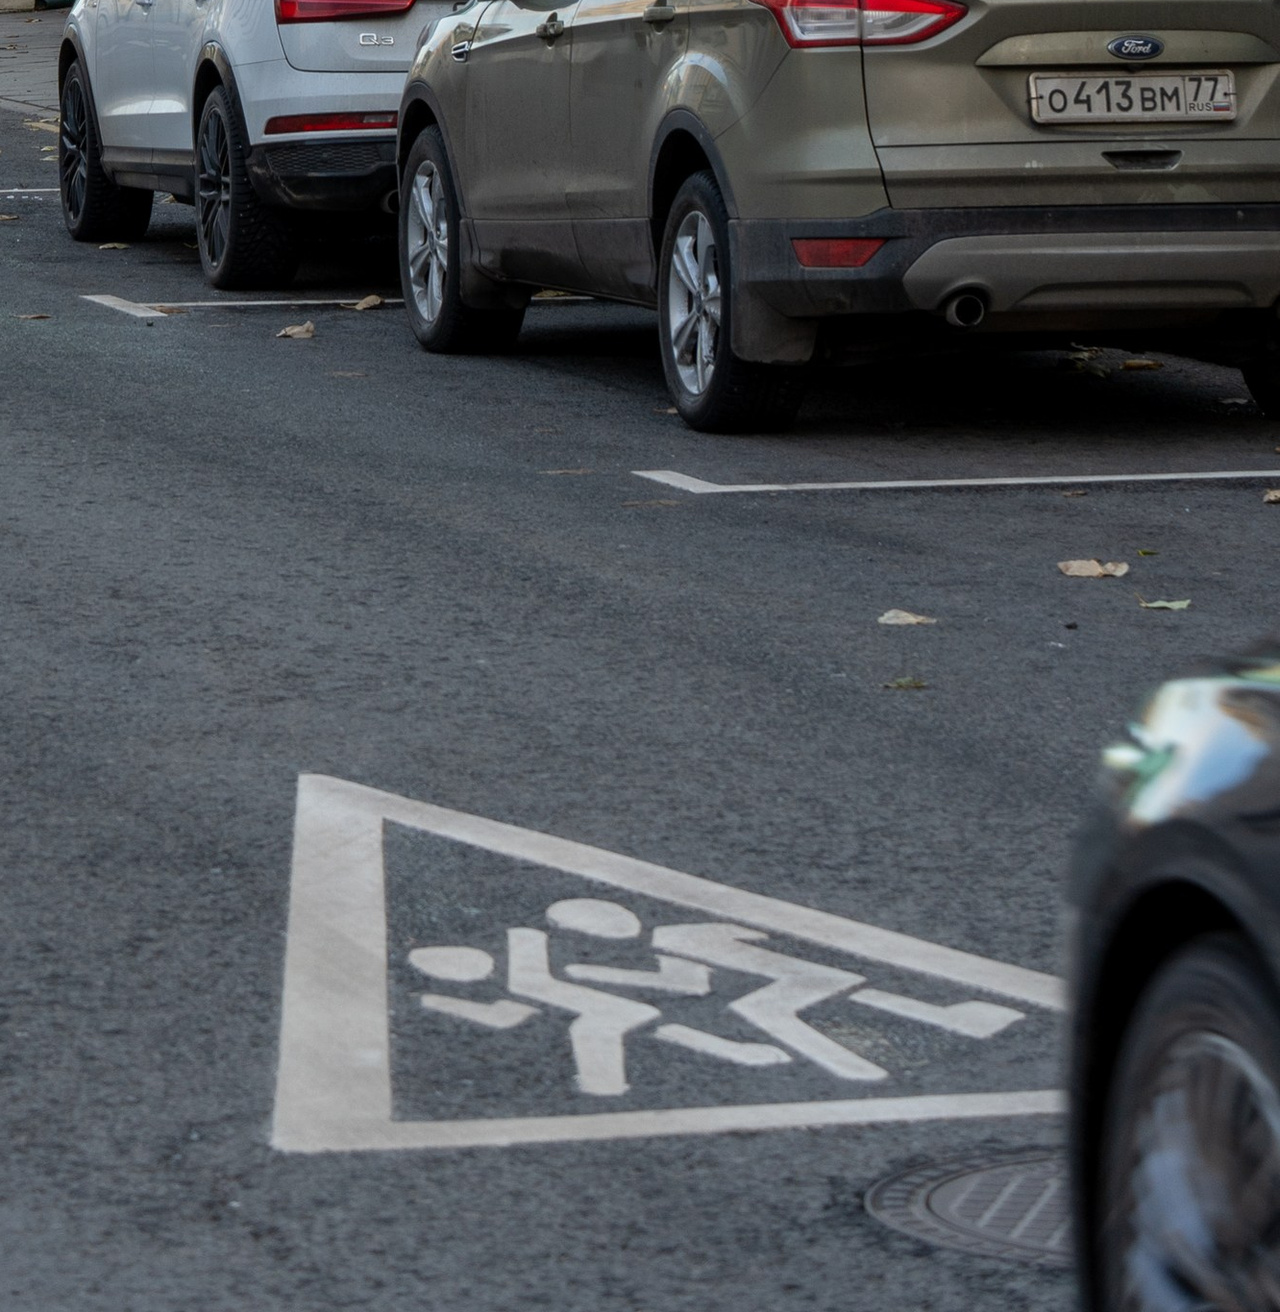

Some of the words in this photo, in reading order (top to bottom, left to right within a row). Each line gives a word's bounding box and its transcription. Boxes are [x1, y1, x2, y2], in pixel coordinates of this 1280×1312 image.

[360, 33, 394, 45] Q3
[1121, 39, 1152, 53] Ford
[1048, 80, 1181, 113] О413ВМ
[1188, 78, 1218, 102] 77
[1189, 103, 1212, 112] RUS
